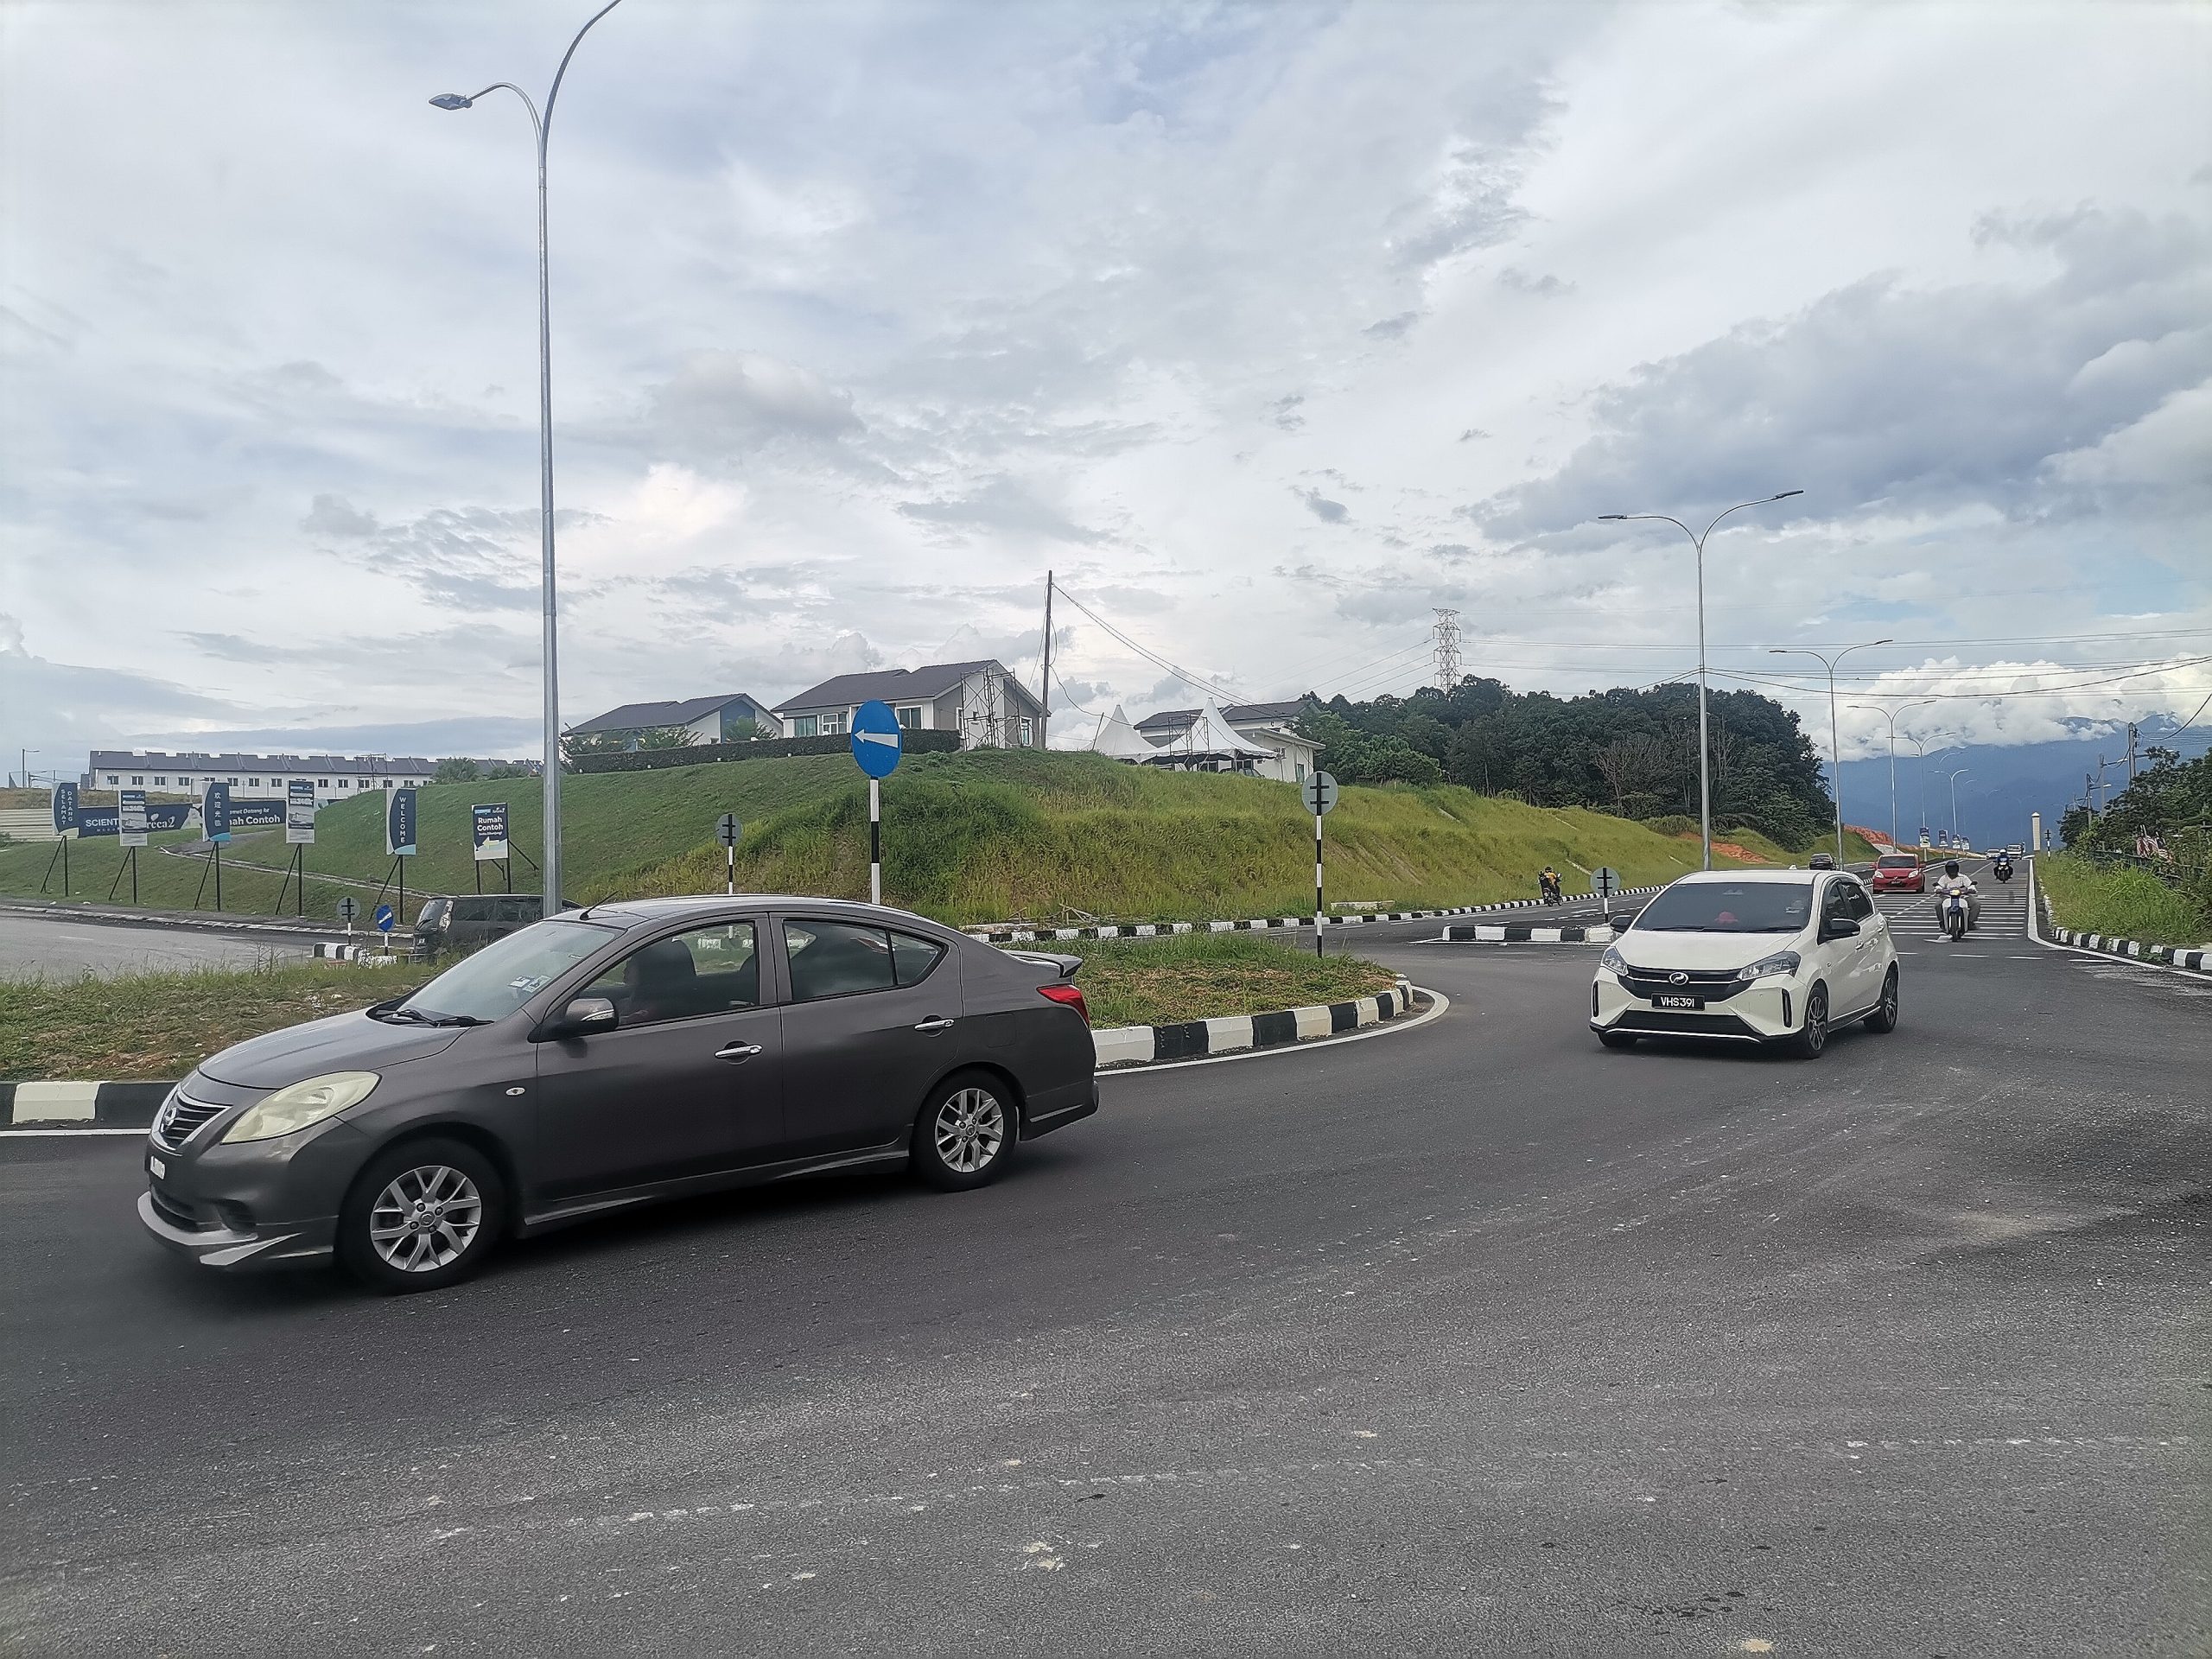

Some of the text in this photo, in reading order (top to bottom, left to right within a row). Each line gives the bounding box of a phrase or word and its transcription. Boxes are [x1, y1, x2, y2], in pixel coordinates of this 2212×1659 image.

[85, 817, 119, 828] SCIENT
[245, 814, 281, 825] Contoh
[478, 816, 503, 824] Rumah
[477, 823, 504, 831] Contoh
[1660, 996, 1695, 1007] VHS391
